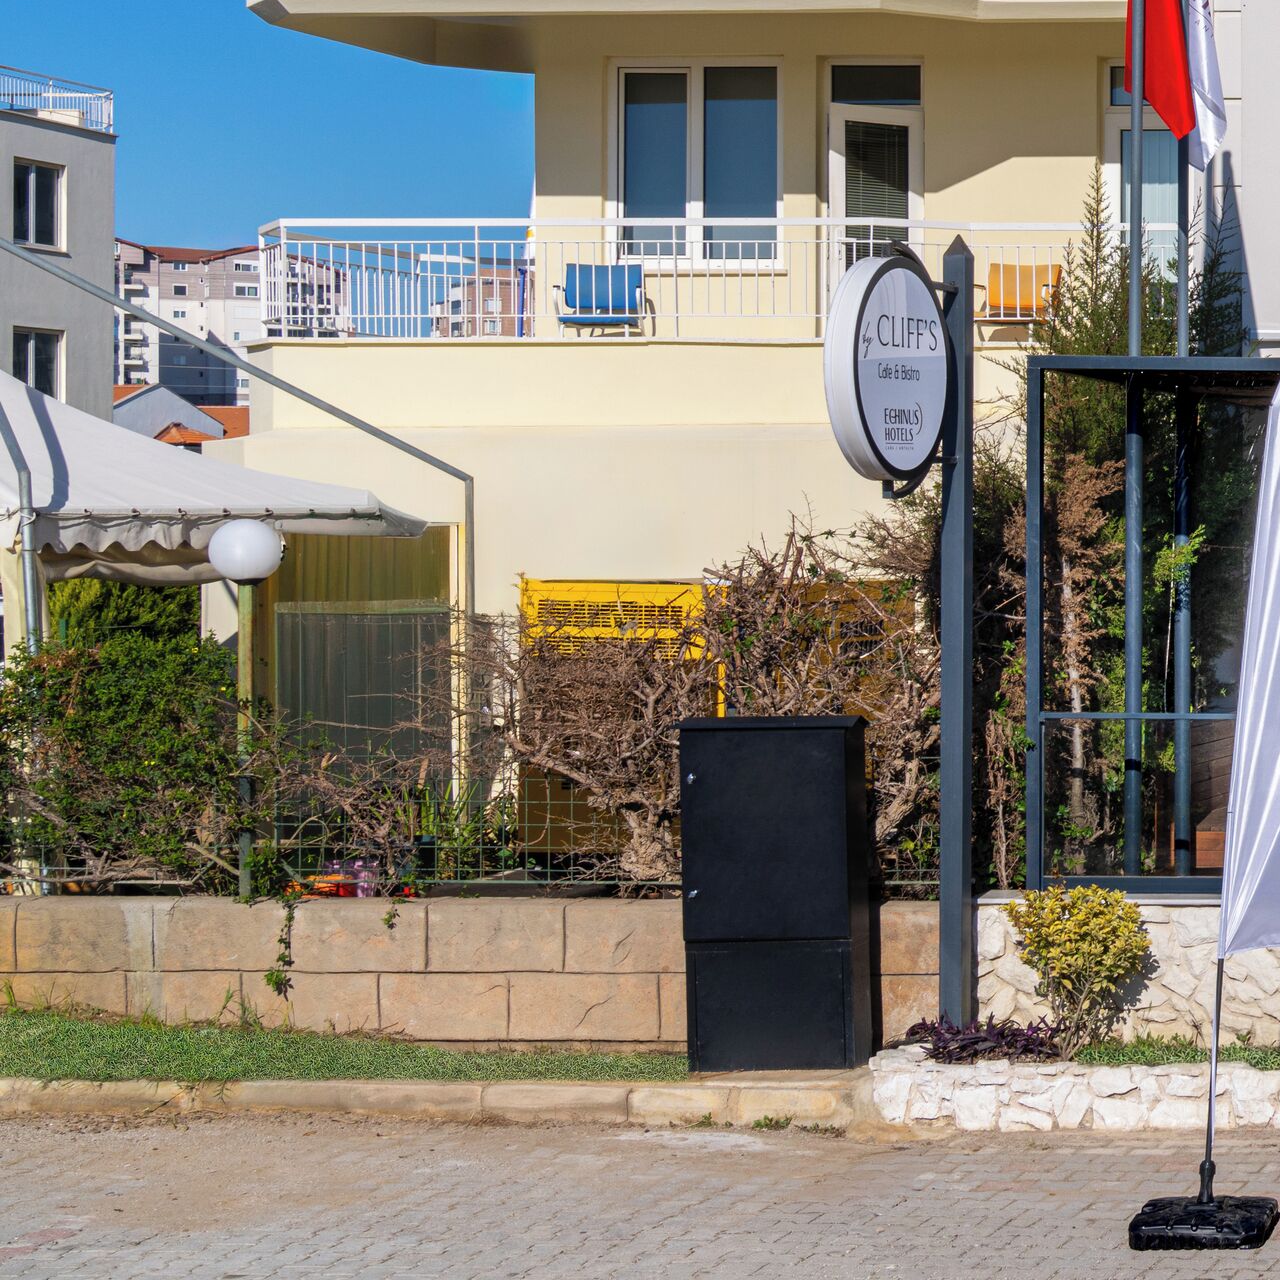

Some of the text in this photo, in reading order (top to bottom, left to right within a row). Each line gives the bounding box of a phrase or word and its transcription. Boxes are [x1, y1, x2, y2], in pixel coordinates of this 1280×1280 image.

[862, 314, 937, 359] by CLIFF'S
[878, 362, 920, 381] Cafe & Bistro
[884, 408, 919, 425] ECHINUS
[885, 428, 913, 441] HOTELS
